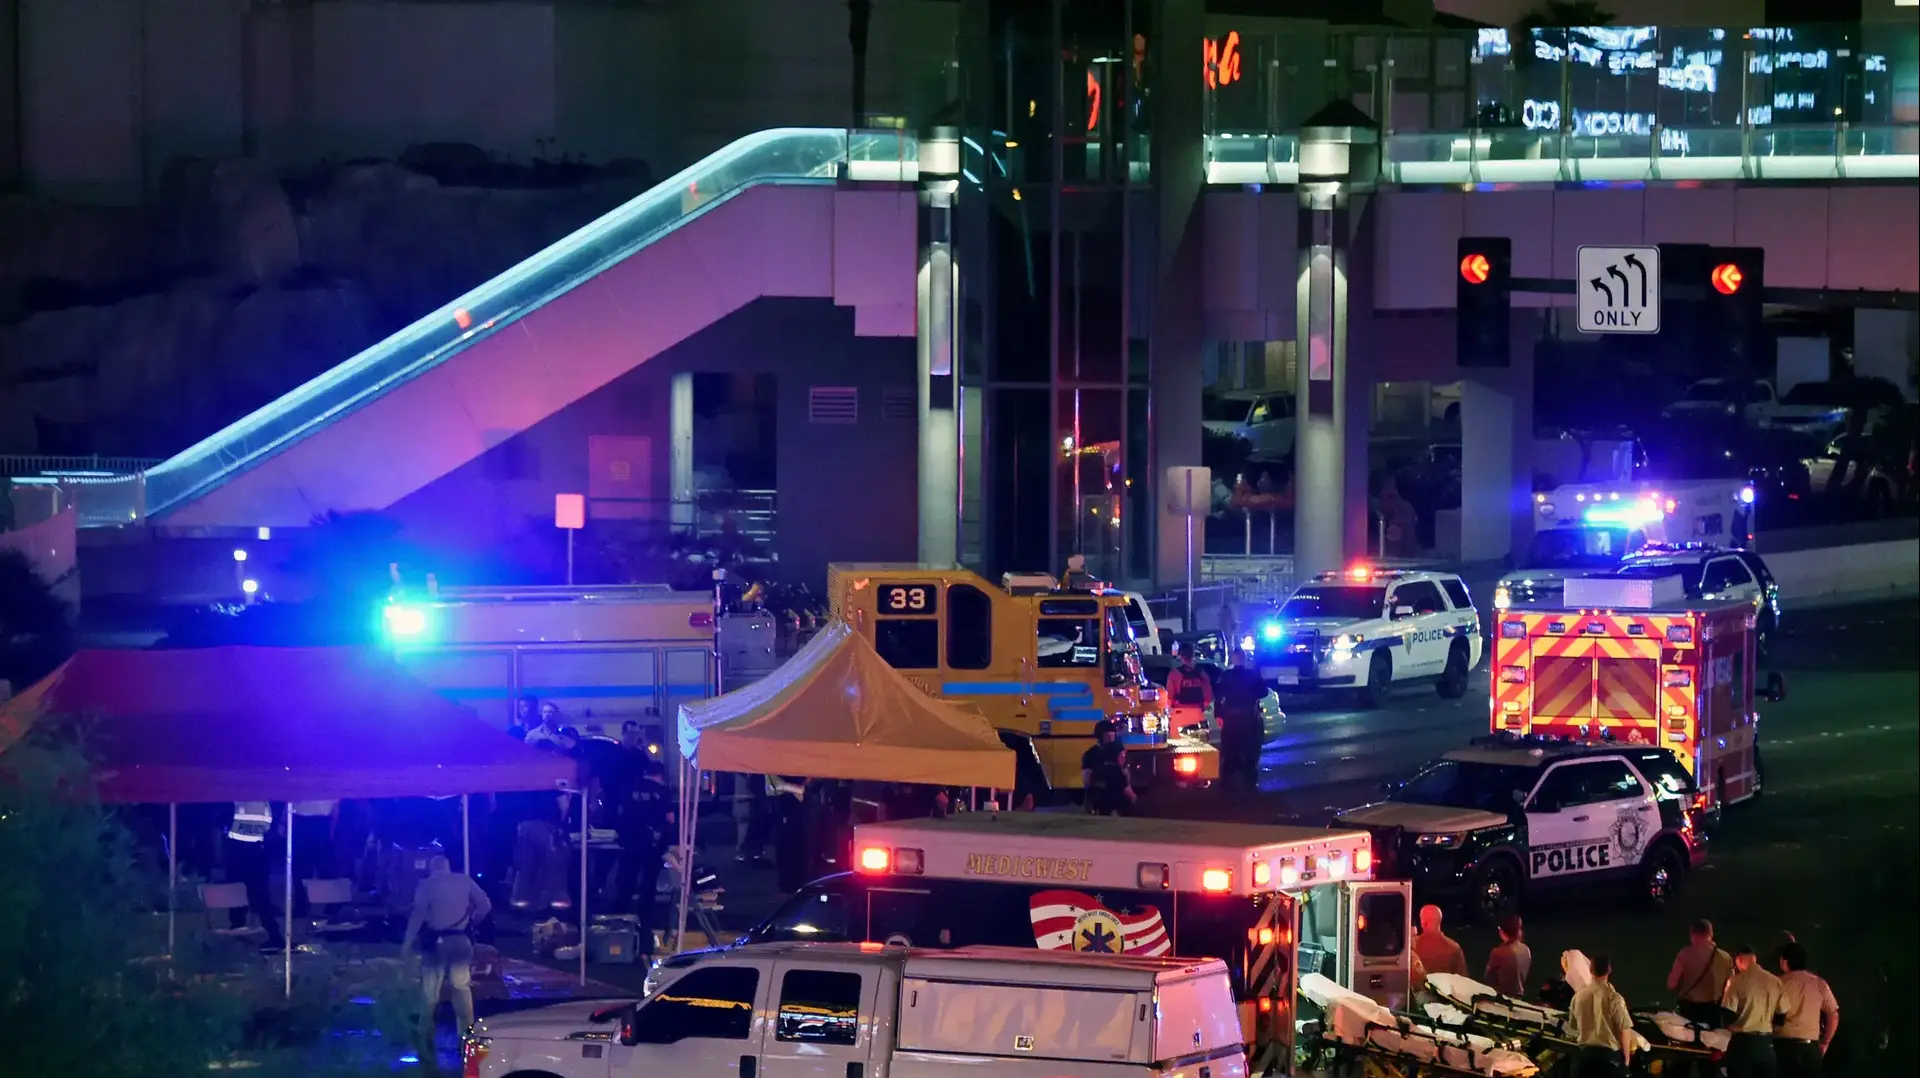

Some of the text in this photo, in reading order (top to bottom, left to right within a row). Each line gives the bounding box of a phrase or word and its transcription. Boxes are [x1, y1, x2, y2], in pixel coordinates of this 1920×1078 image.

[1594, 310, 1641, 326] ONLY
[890, 588, 925, 609] 33
[1412, 629, 1442, 643] POLICE
[1673, 650, 1684, 663] 4
[967, 853, 1092, 881] MEDICWEST
[1532, 844, 1610, 875] POLICE
